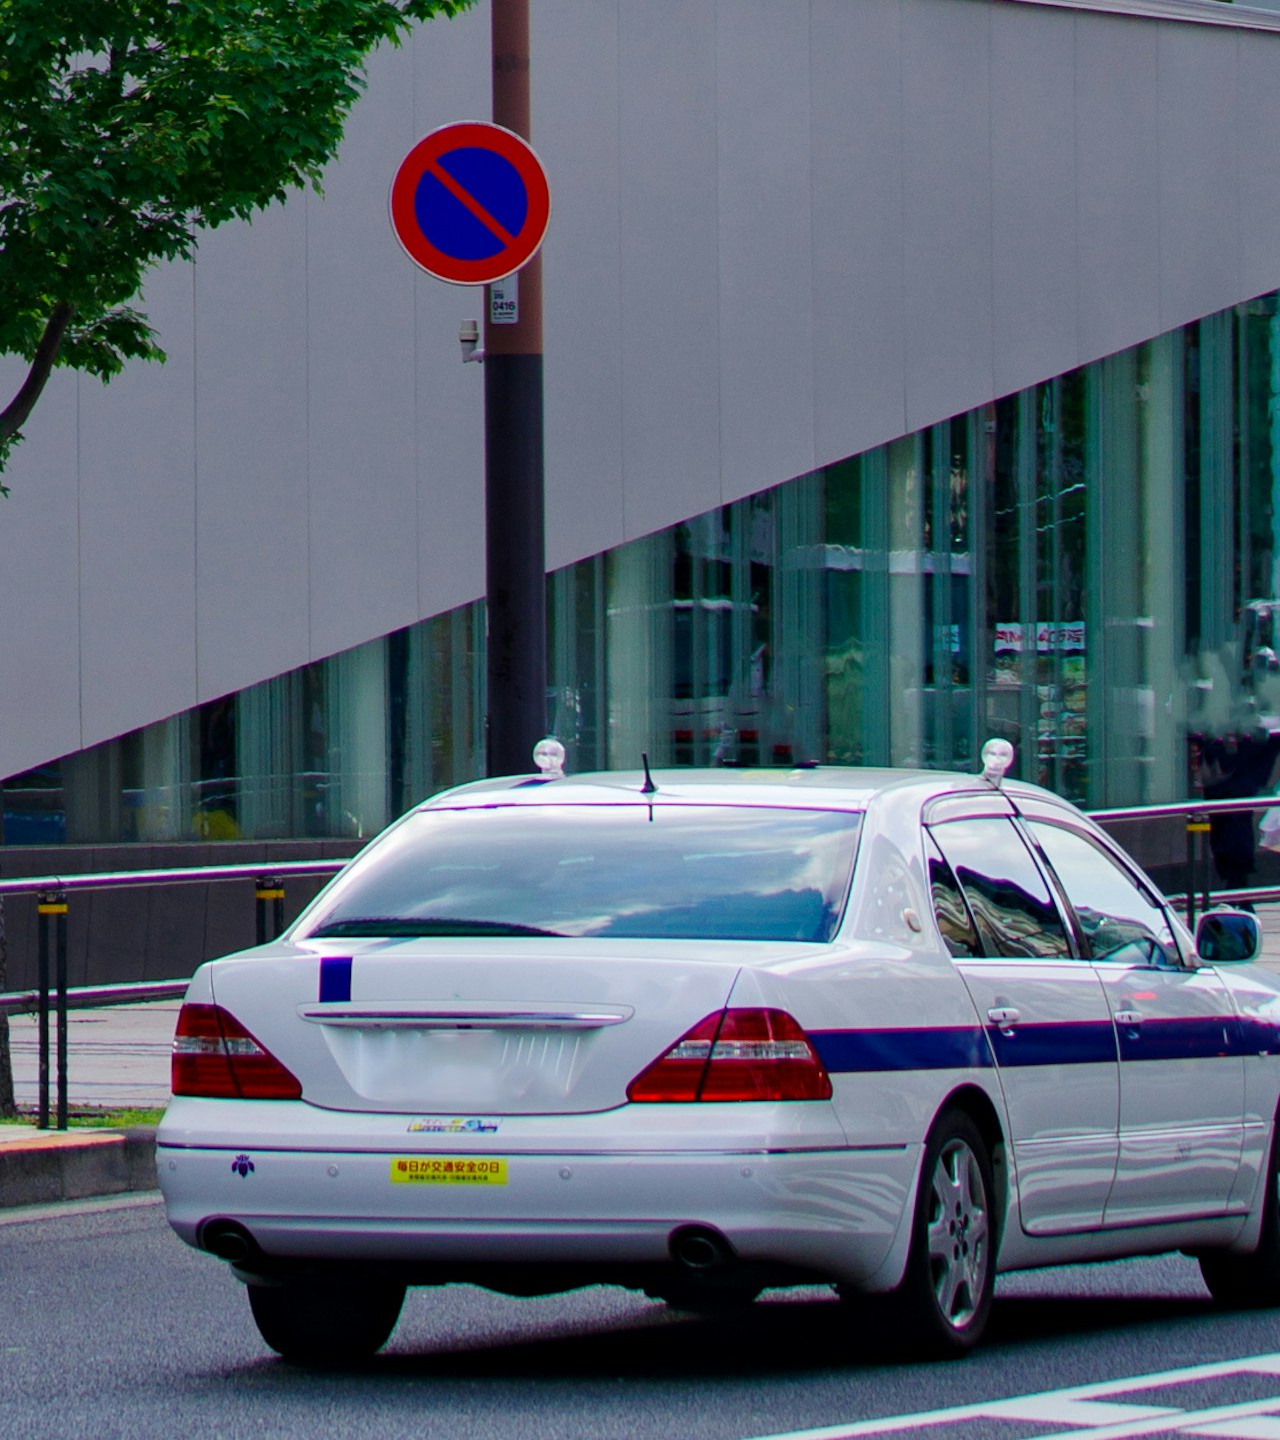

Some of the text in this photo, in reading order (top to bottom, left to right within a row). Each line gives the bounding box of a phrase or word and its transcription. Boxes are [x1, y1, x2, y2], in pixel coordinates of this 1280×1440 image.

[397, 1160, 500, 1174] 毎日が交通安全の日
